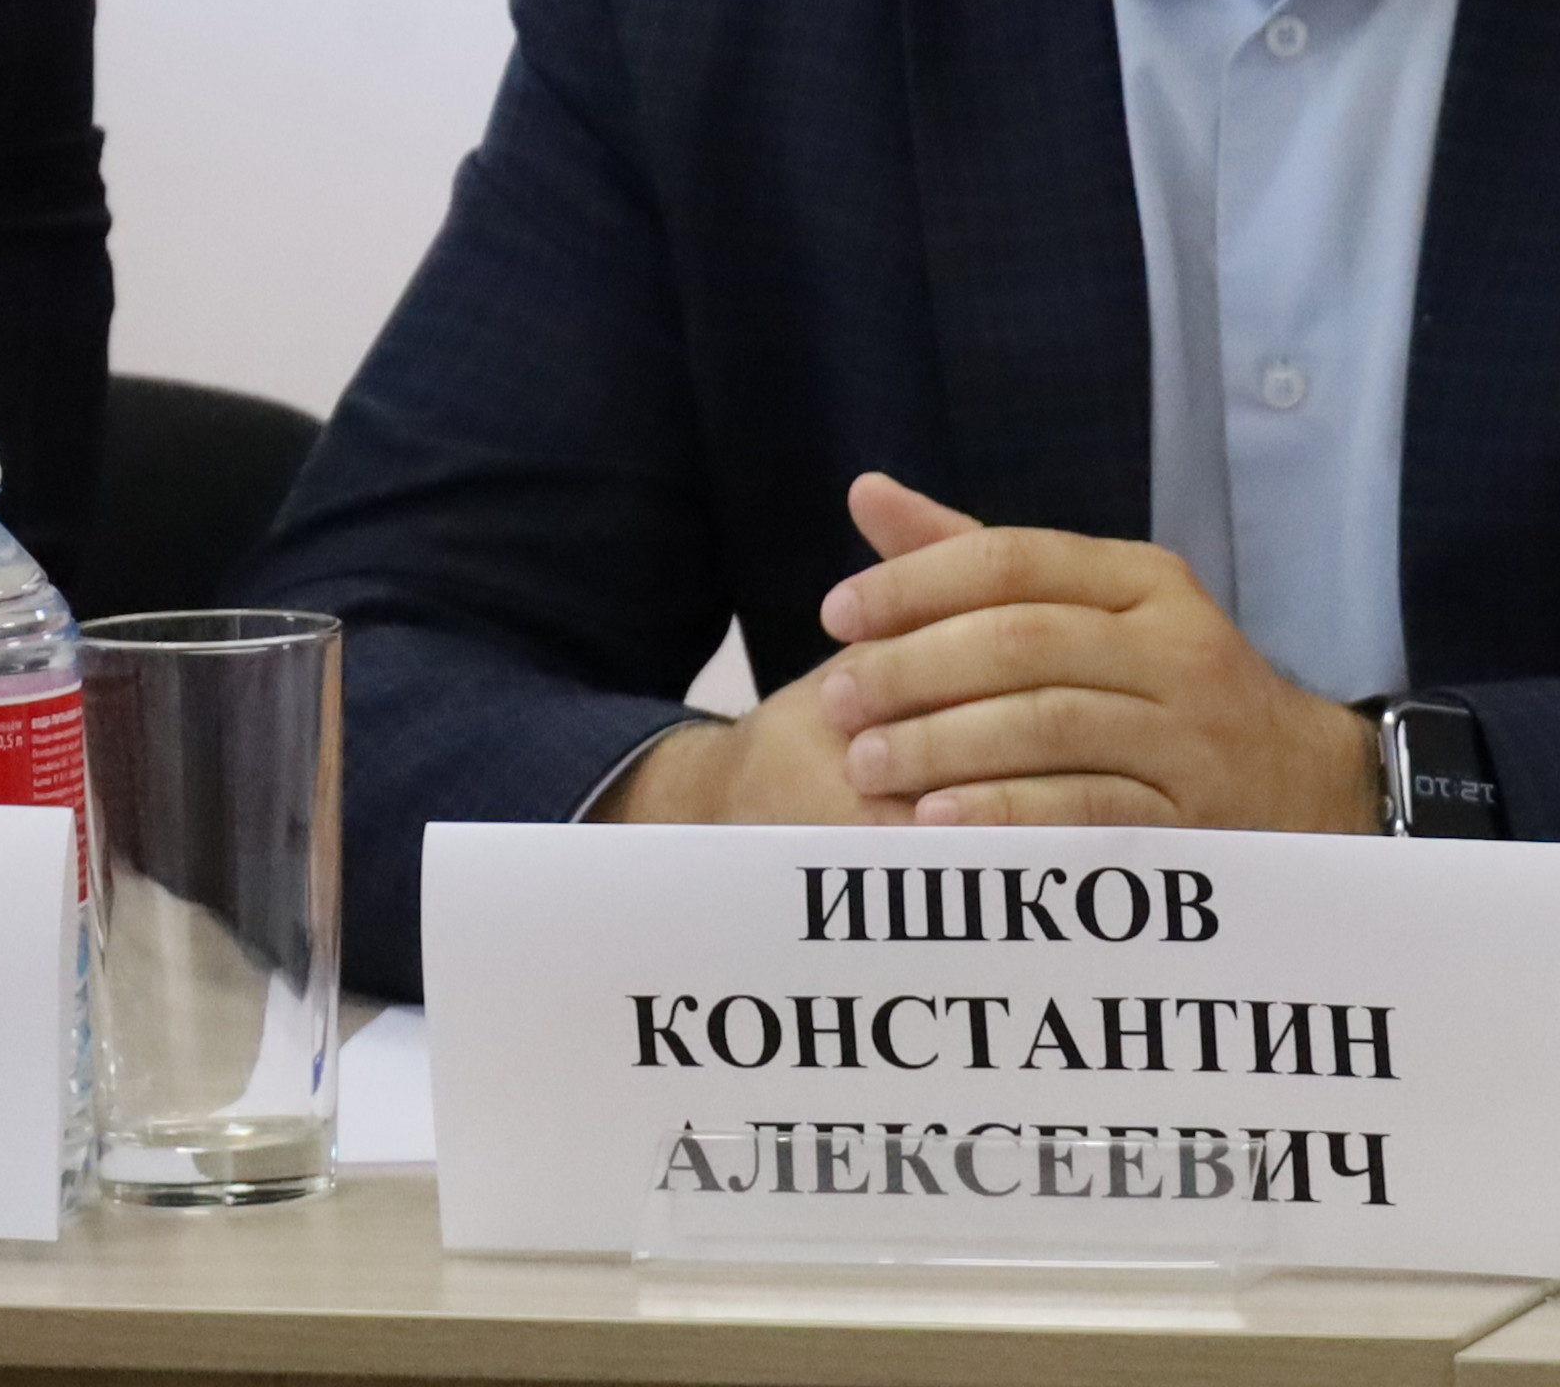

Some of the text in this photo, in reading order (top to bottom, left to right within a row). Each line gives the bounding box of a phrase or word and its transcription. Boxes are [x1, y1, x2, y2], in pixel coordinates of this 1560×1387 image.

[795, 867, 1220, 942] ИШКОВ
[625, 994, 1402, 1080] КОНСТАНТИН
[653, 1119, 1398, 1206] АЛЕКСЕЕВИЧ
